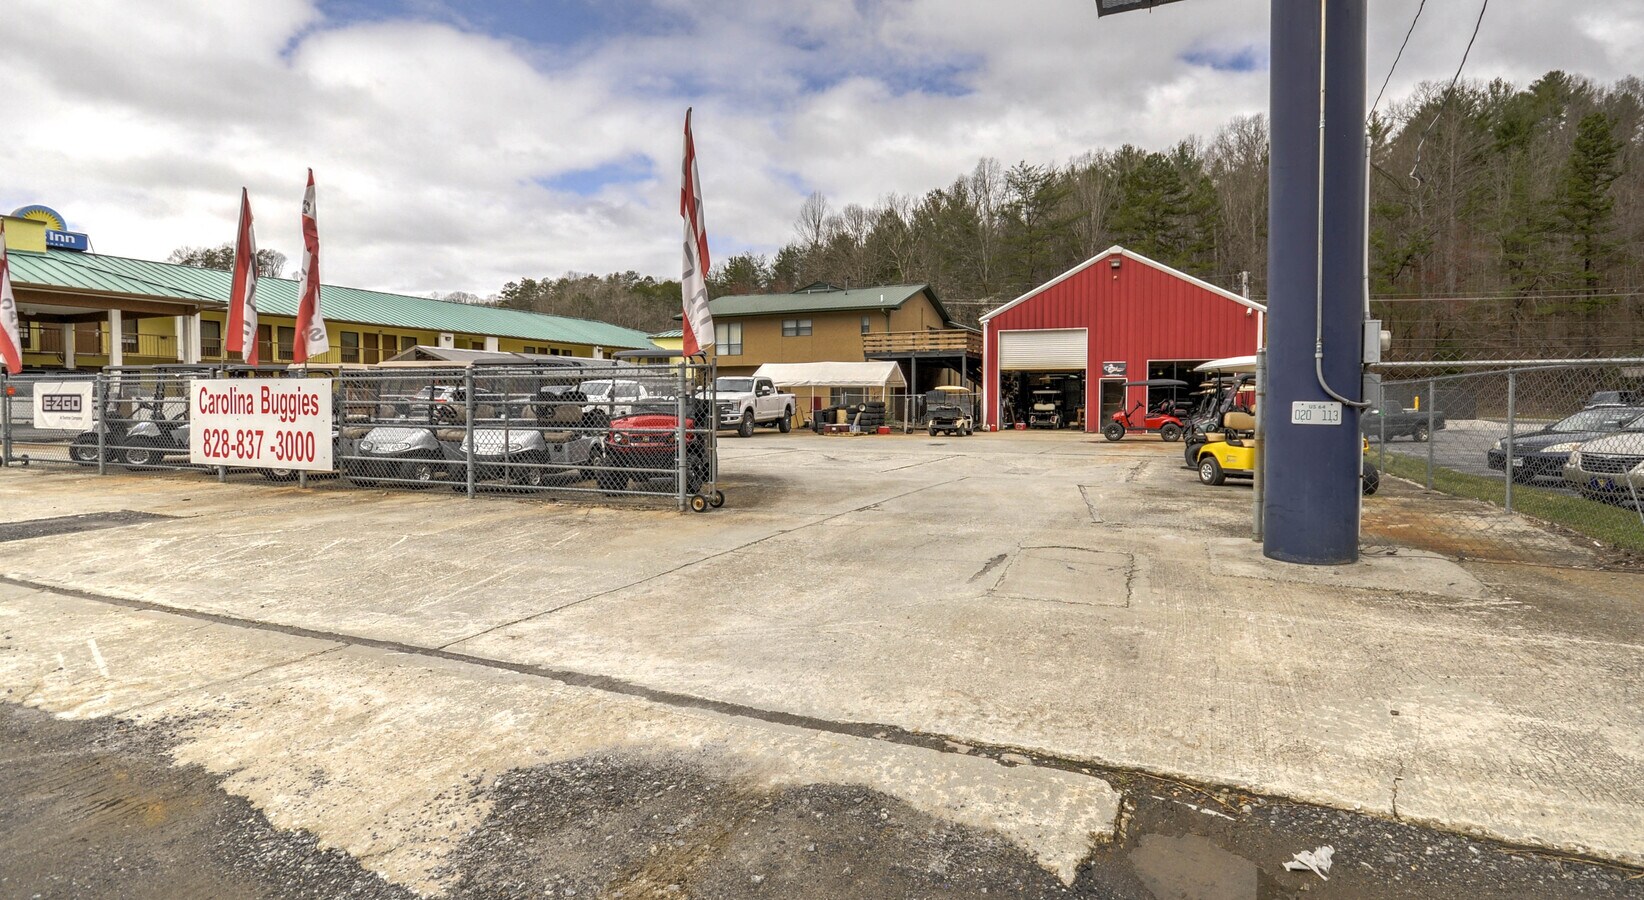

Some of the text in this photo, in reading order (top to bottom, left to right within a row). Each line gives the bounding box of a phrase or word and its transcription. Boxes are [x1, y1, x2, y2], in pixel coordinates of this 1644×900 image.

[50, 231, 76, 244] Inn
[199, 385, 319, 423] Carolina Buggies
[1294, 409, 1339, 421] 020 113
[203, 428, 315, 463] 828-837 -3000
